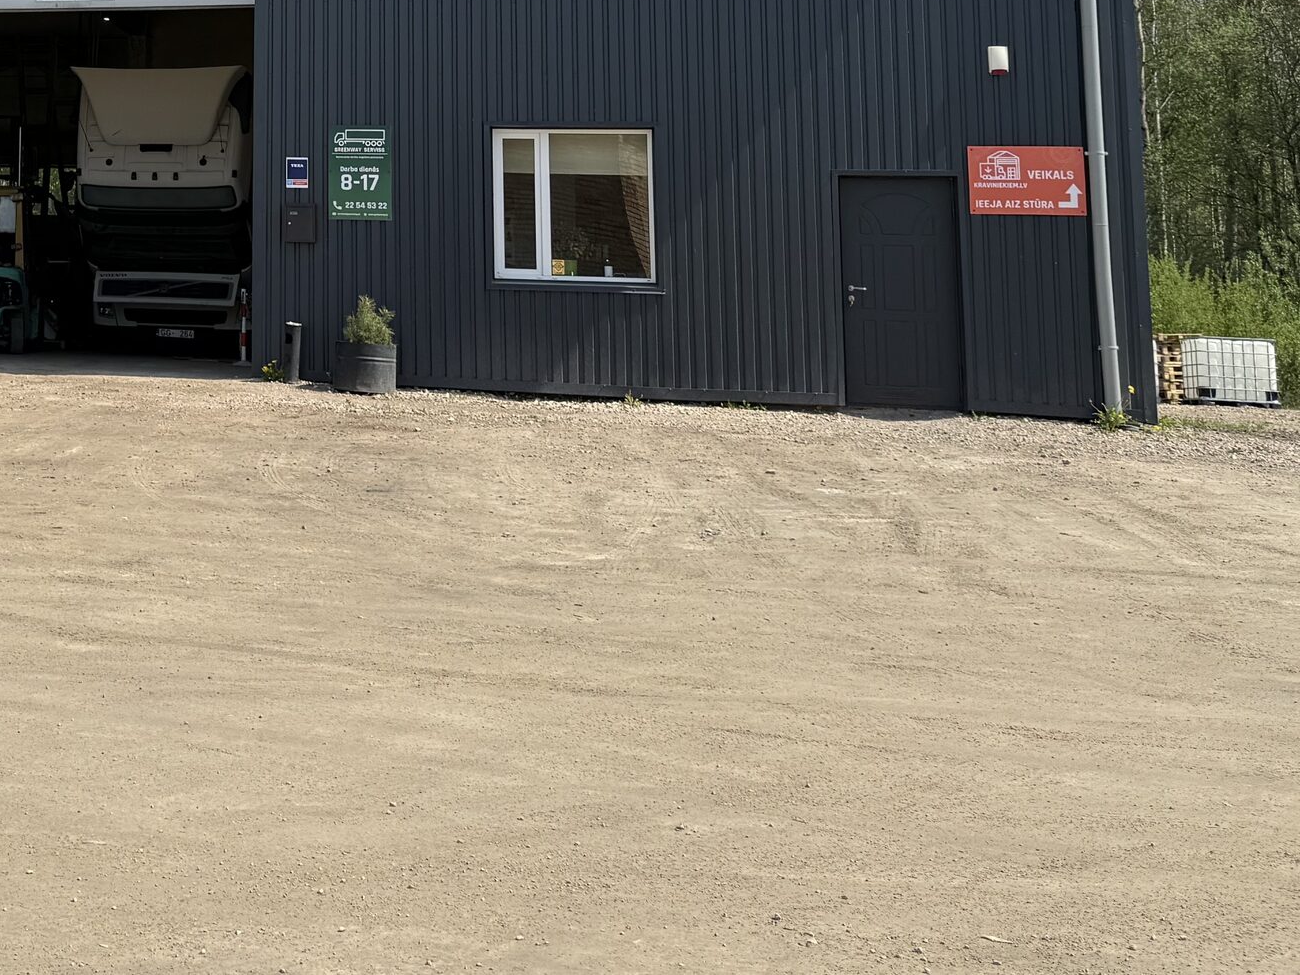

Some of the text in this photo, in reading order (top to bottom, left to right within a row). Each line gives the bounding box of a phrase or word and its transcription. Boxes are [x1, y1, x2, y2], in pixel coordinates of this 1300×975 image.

[1028, 170, 1074, 179] VEIKALS
[341, 174, 379, 191] 8-17
[976, 198, 1054, 209] IEEJA AIZ STŪRA
